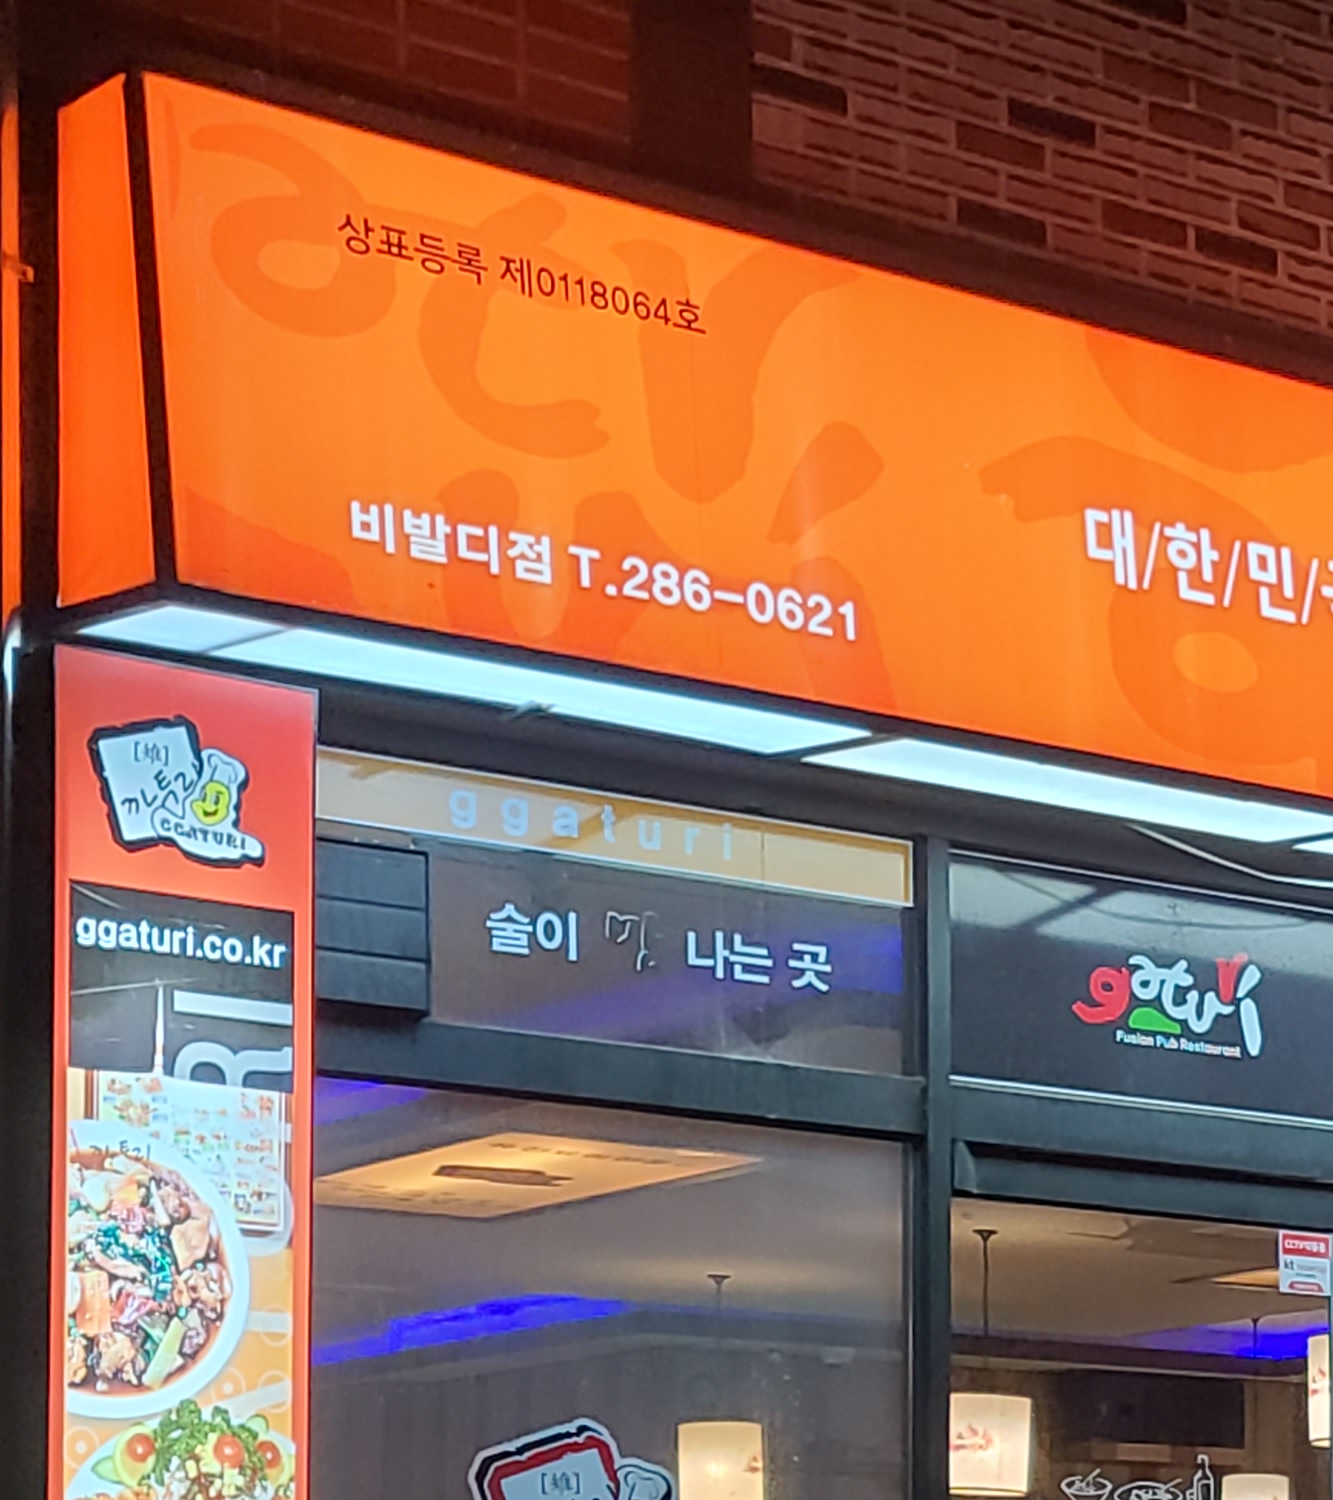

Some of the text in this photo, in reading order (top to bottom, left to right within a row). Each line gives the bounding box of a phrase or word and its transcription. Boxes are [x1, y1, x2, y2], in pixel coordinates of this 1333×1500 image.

[337, 214, 706, 335] 상표등록 제0118064호
[350, 501, 858, 641] 비발디점 T.286-0621
[448, 788, 733, 861] ggaturi
[75, 915, 287, 969] ggaturi.co.kr
[485, 901, 579, 963] 술이
[686, 928, 774, 984] 나는
[787, 941, 833, 994] 곳
